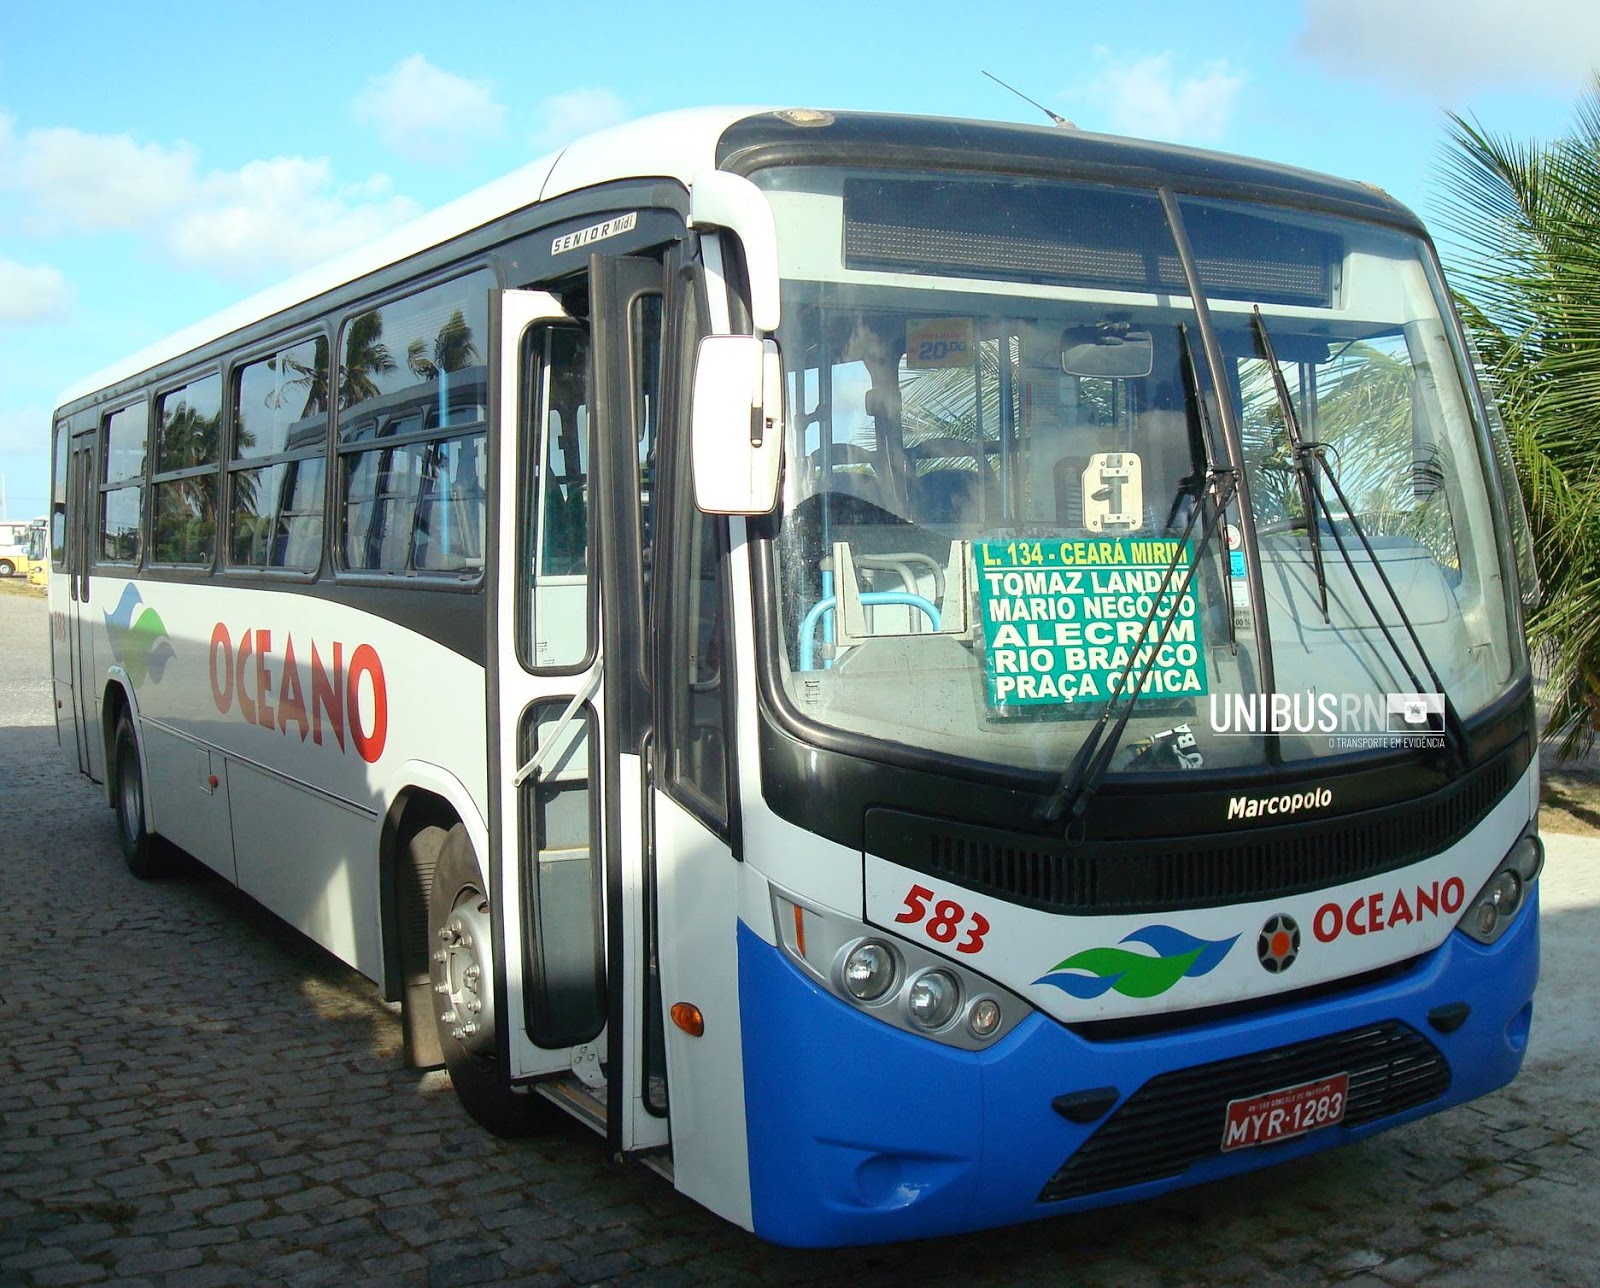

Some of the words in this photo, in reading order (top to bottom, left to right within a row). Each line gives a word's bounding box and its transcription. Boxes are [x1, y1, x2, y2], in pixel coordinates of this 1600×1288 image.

[554, 223, 611, 252] SENIOR
[613, 214, 634, 233] Midi
[983, 543, 1002, 566] L.
[1007, 542, 1044, 565] 134
[1060, 537, 1127, 565] CEARÁ
[1130, 542, 1188, 564] MIRIM
[984, 571, 1085, 596] TOMAZ
[988, 590, 1076, 622] MÁRIO
[992, 619, 1196, 648] ALECRIM
[995, 648, 1055, 673] RIO
[1065, 643, 1198, 671] BRANCO
[209, 621, 389, 764] OCEANO
[996, 673, 1099, 703] PRAÇA
[1227, 787, 1333, 820] Marcopolo
[894, 883, 990, 954] 583
[1312, 876, 1465, 944] OCEANO
